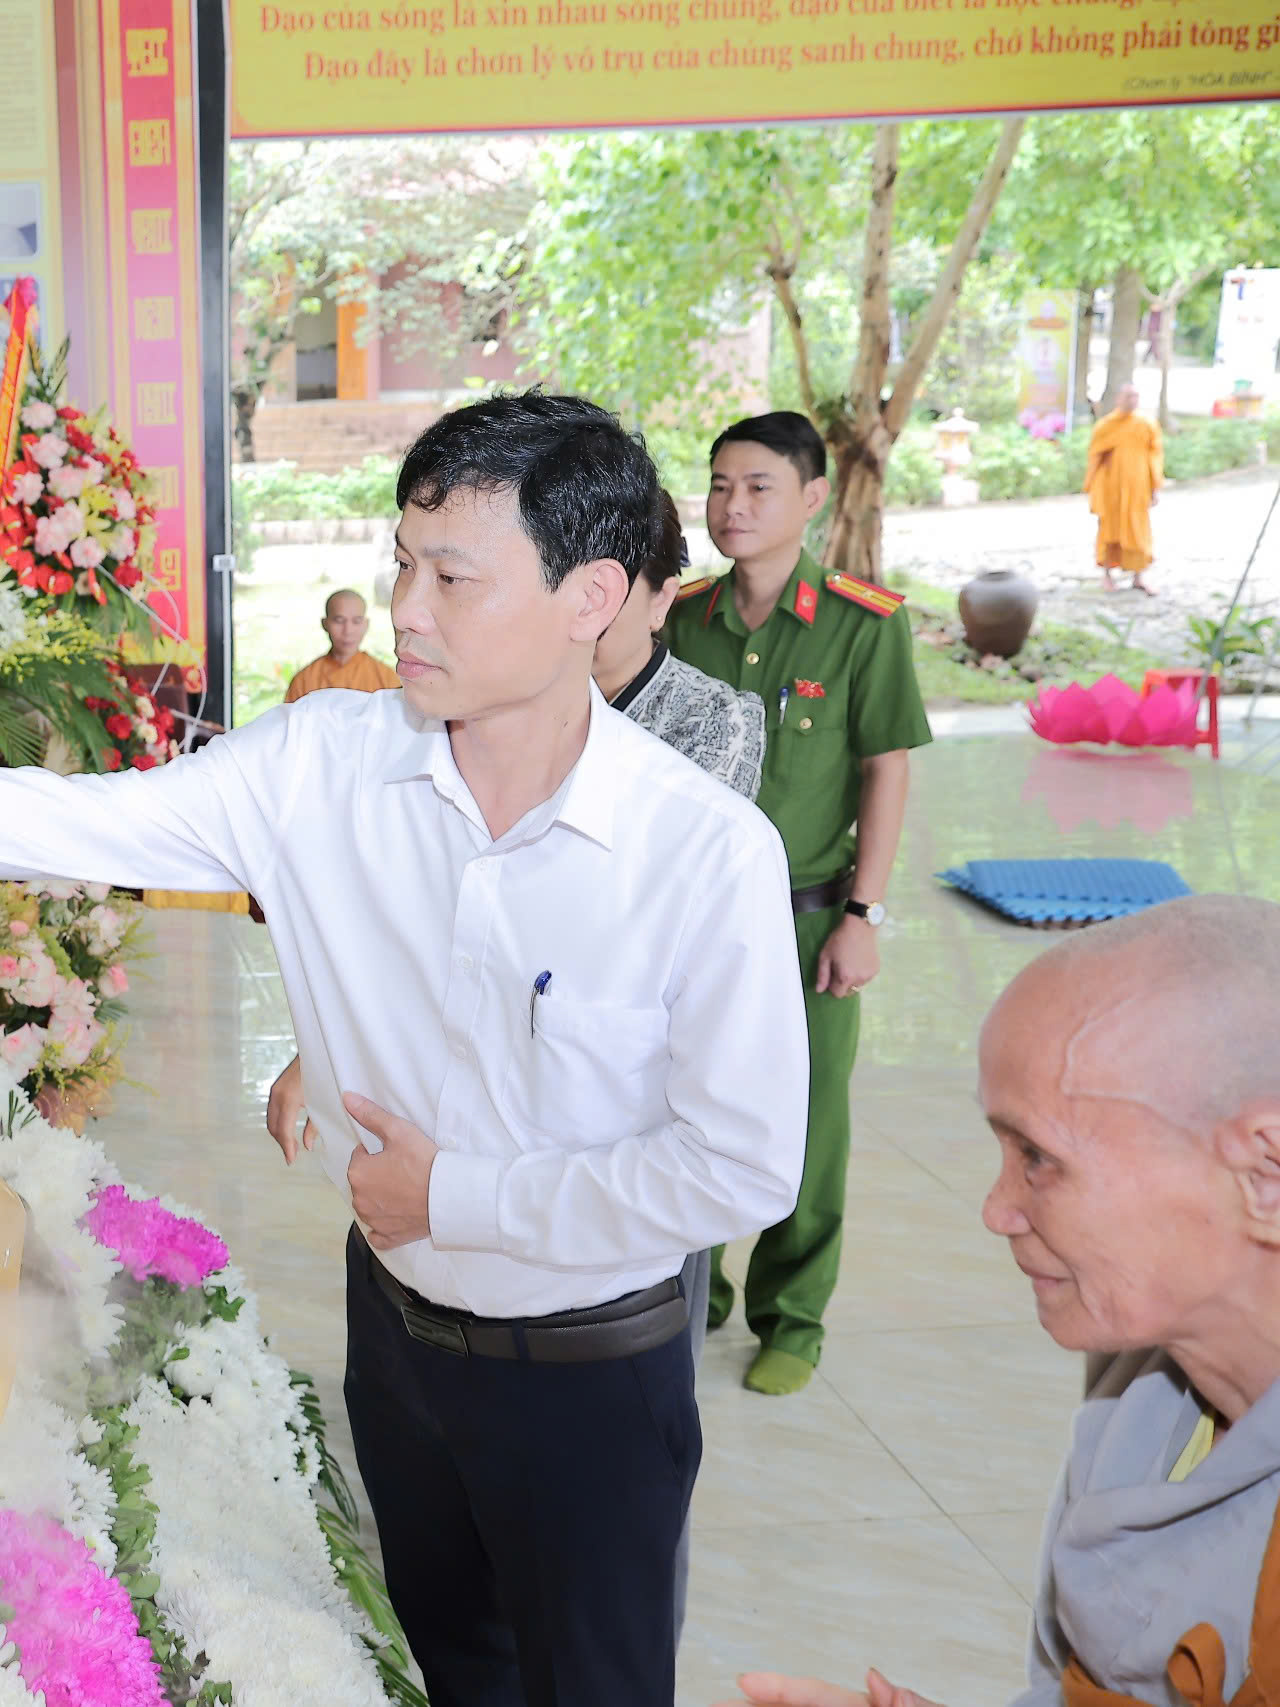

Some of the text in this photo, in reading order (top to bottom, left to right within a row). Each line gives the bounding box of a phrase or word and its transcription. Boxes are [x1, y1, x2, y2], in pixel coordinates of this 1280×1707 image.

[260, 5, 315, 39] Đạo
[322, 0, 370, 31] của
[380, 0, 446, 37] sống
[537, 0, 606, 26] nhau
[304, 51, 359, 86] Đạo
[423, 47, 448, 77] là
[532, 43, 554, 79] lý
[602, 47, 644, 79] trụ
[652, 40, 700, 69] của
[801, 33, 865, 63] sanh
[874, 31, 965, 65] chung,
[1031, 24, 1115, 59] không
[1122, 18, 1183, 57] phải
